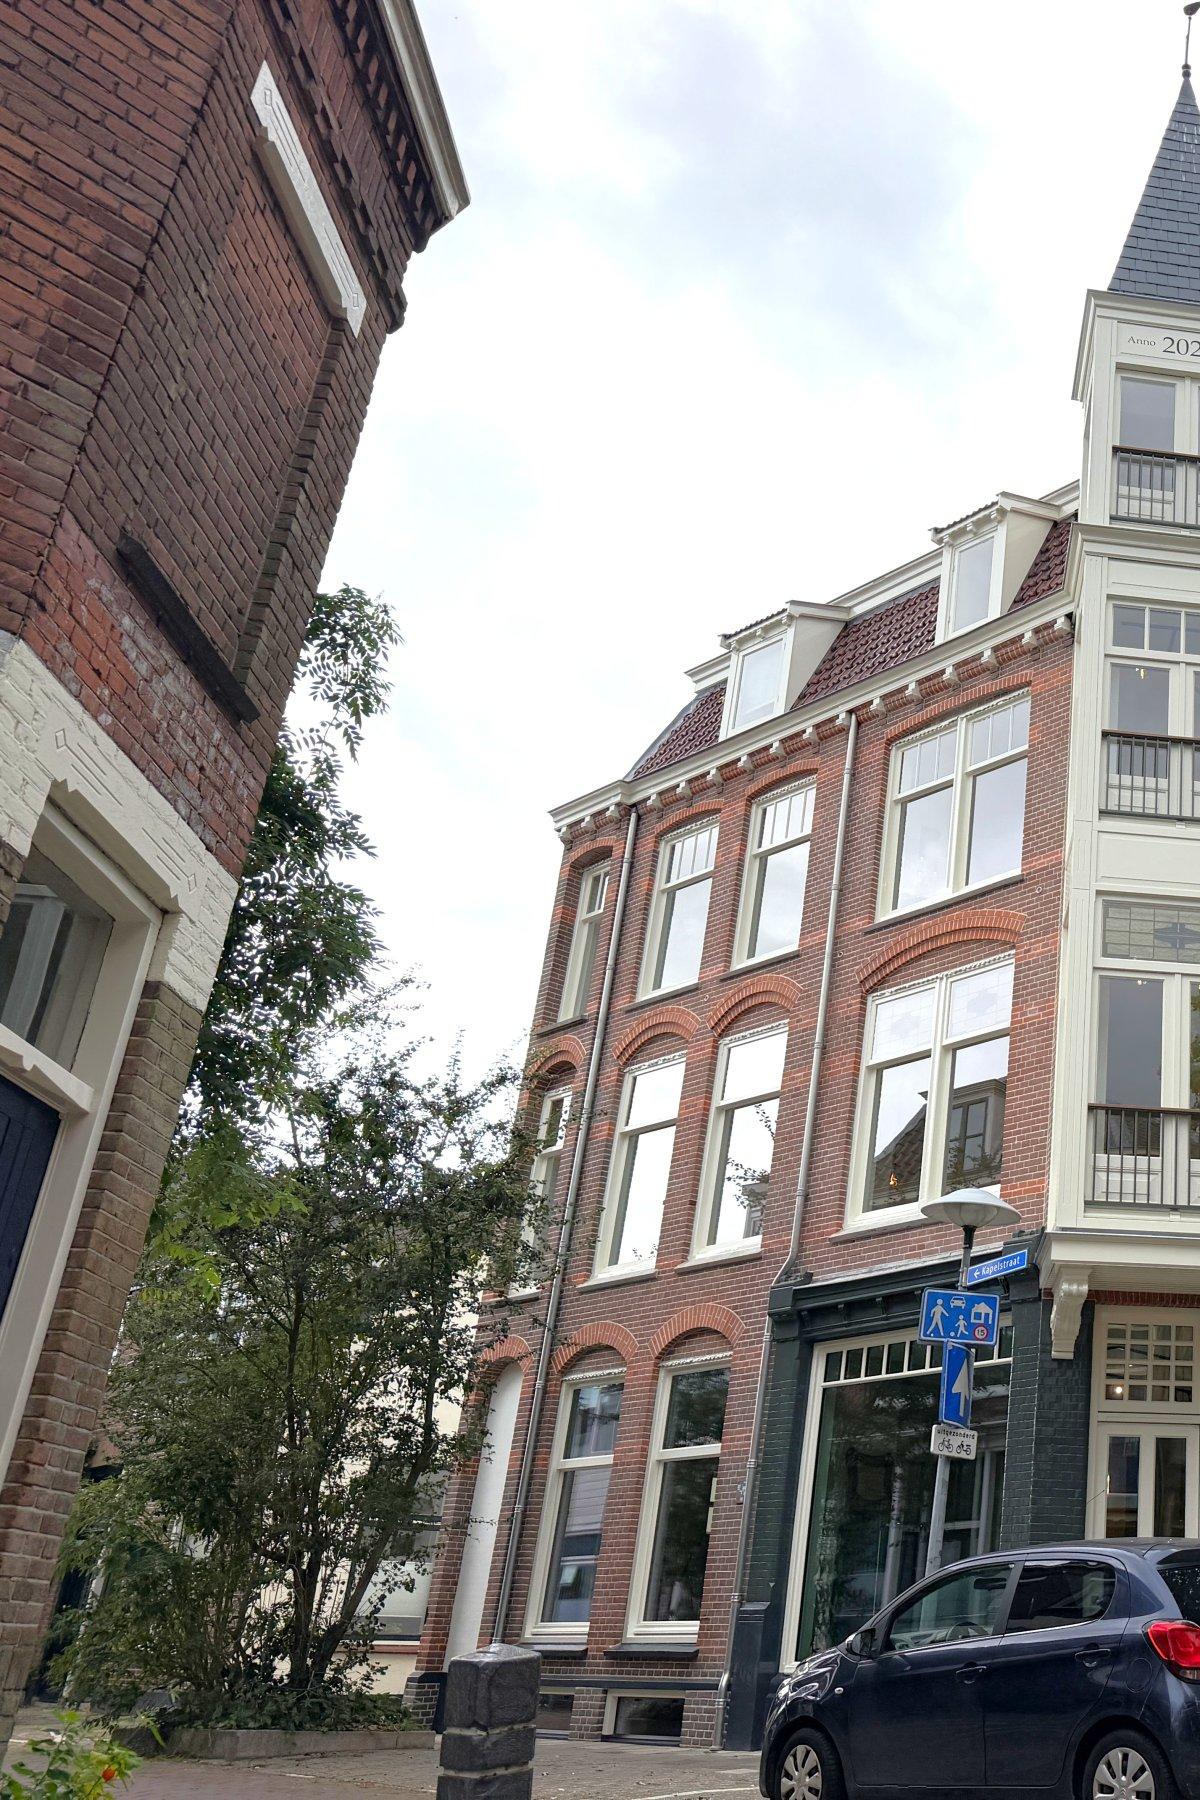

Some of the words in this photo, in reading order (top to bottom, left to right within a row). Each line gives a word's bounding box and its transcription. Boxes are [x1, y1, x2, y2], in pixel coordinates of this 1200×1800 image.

[1127, 336, 1156, 347] Anno
[981, 1255, 1020, 1276] Kapelstraat
[977, 1329, 986, 1337] 15
[937, 1429, 975, 1440] uitgezonderd
